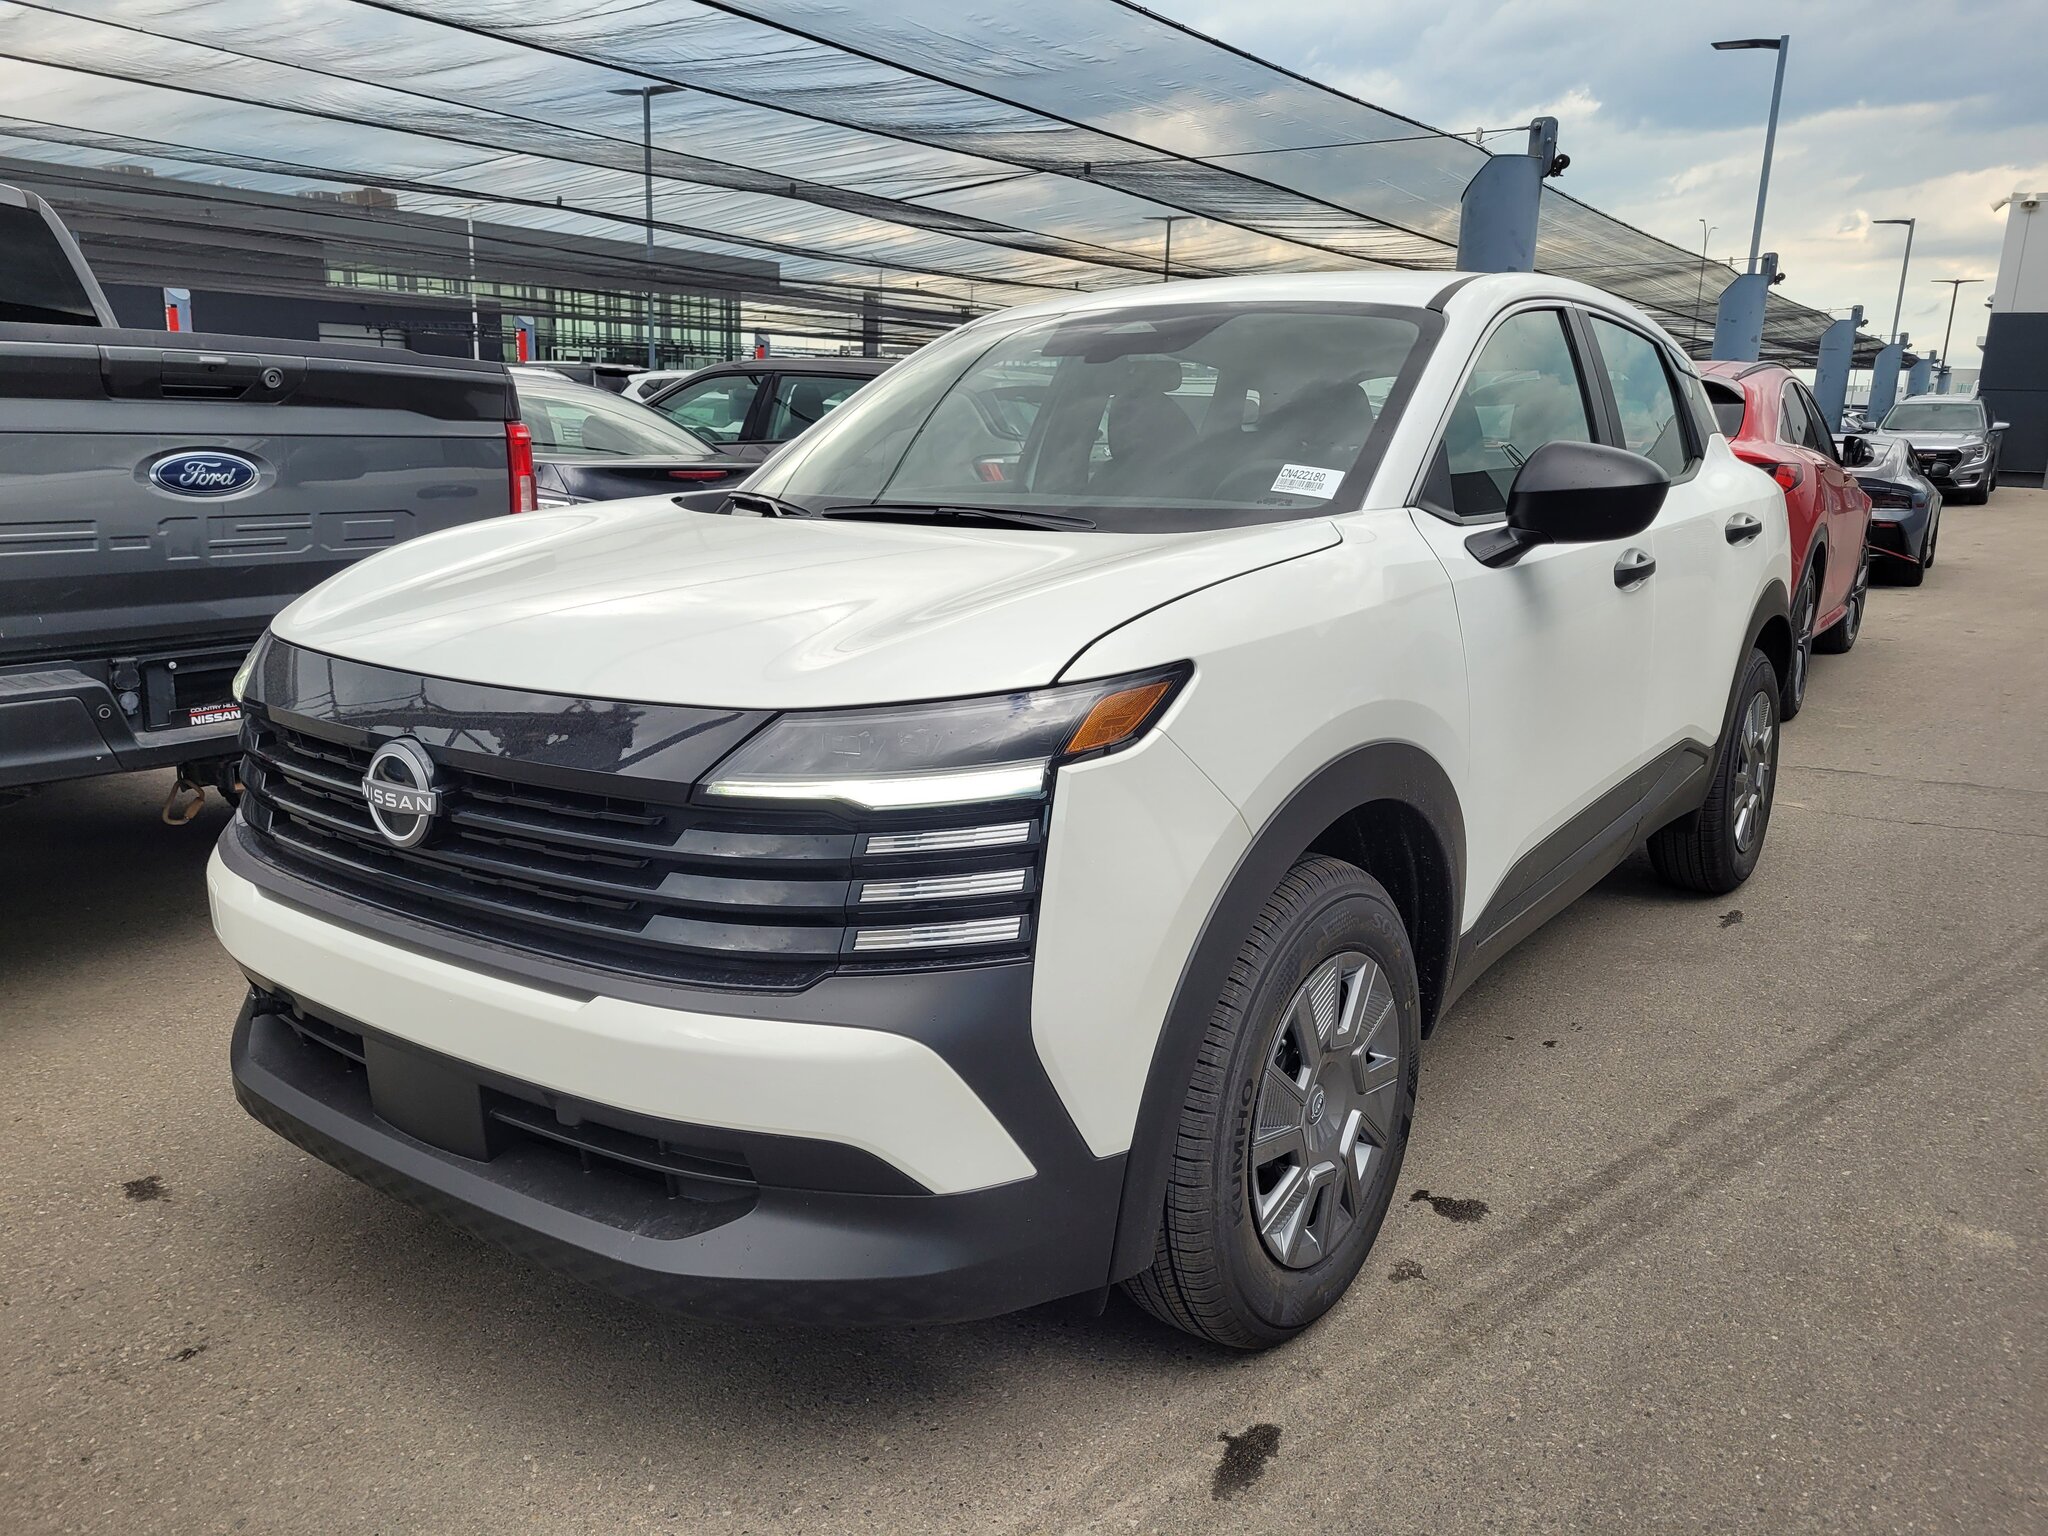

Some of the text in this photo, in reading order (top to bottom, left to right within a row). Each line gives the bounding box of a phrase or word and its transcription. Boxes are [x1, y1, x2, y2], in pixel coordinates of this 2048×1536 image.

[179, 460, 236, 487] Ford
[1280, 468, 1327, 482] CN422180
[190, 704, 222, 714] COUNTRY
[191, 709, 242, 726] NISSAN
[361, 781, 433, 812] NISSAN
[1231, 1077, 1254, 1228] KUMHO
